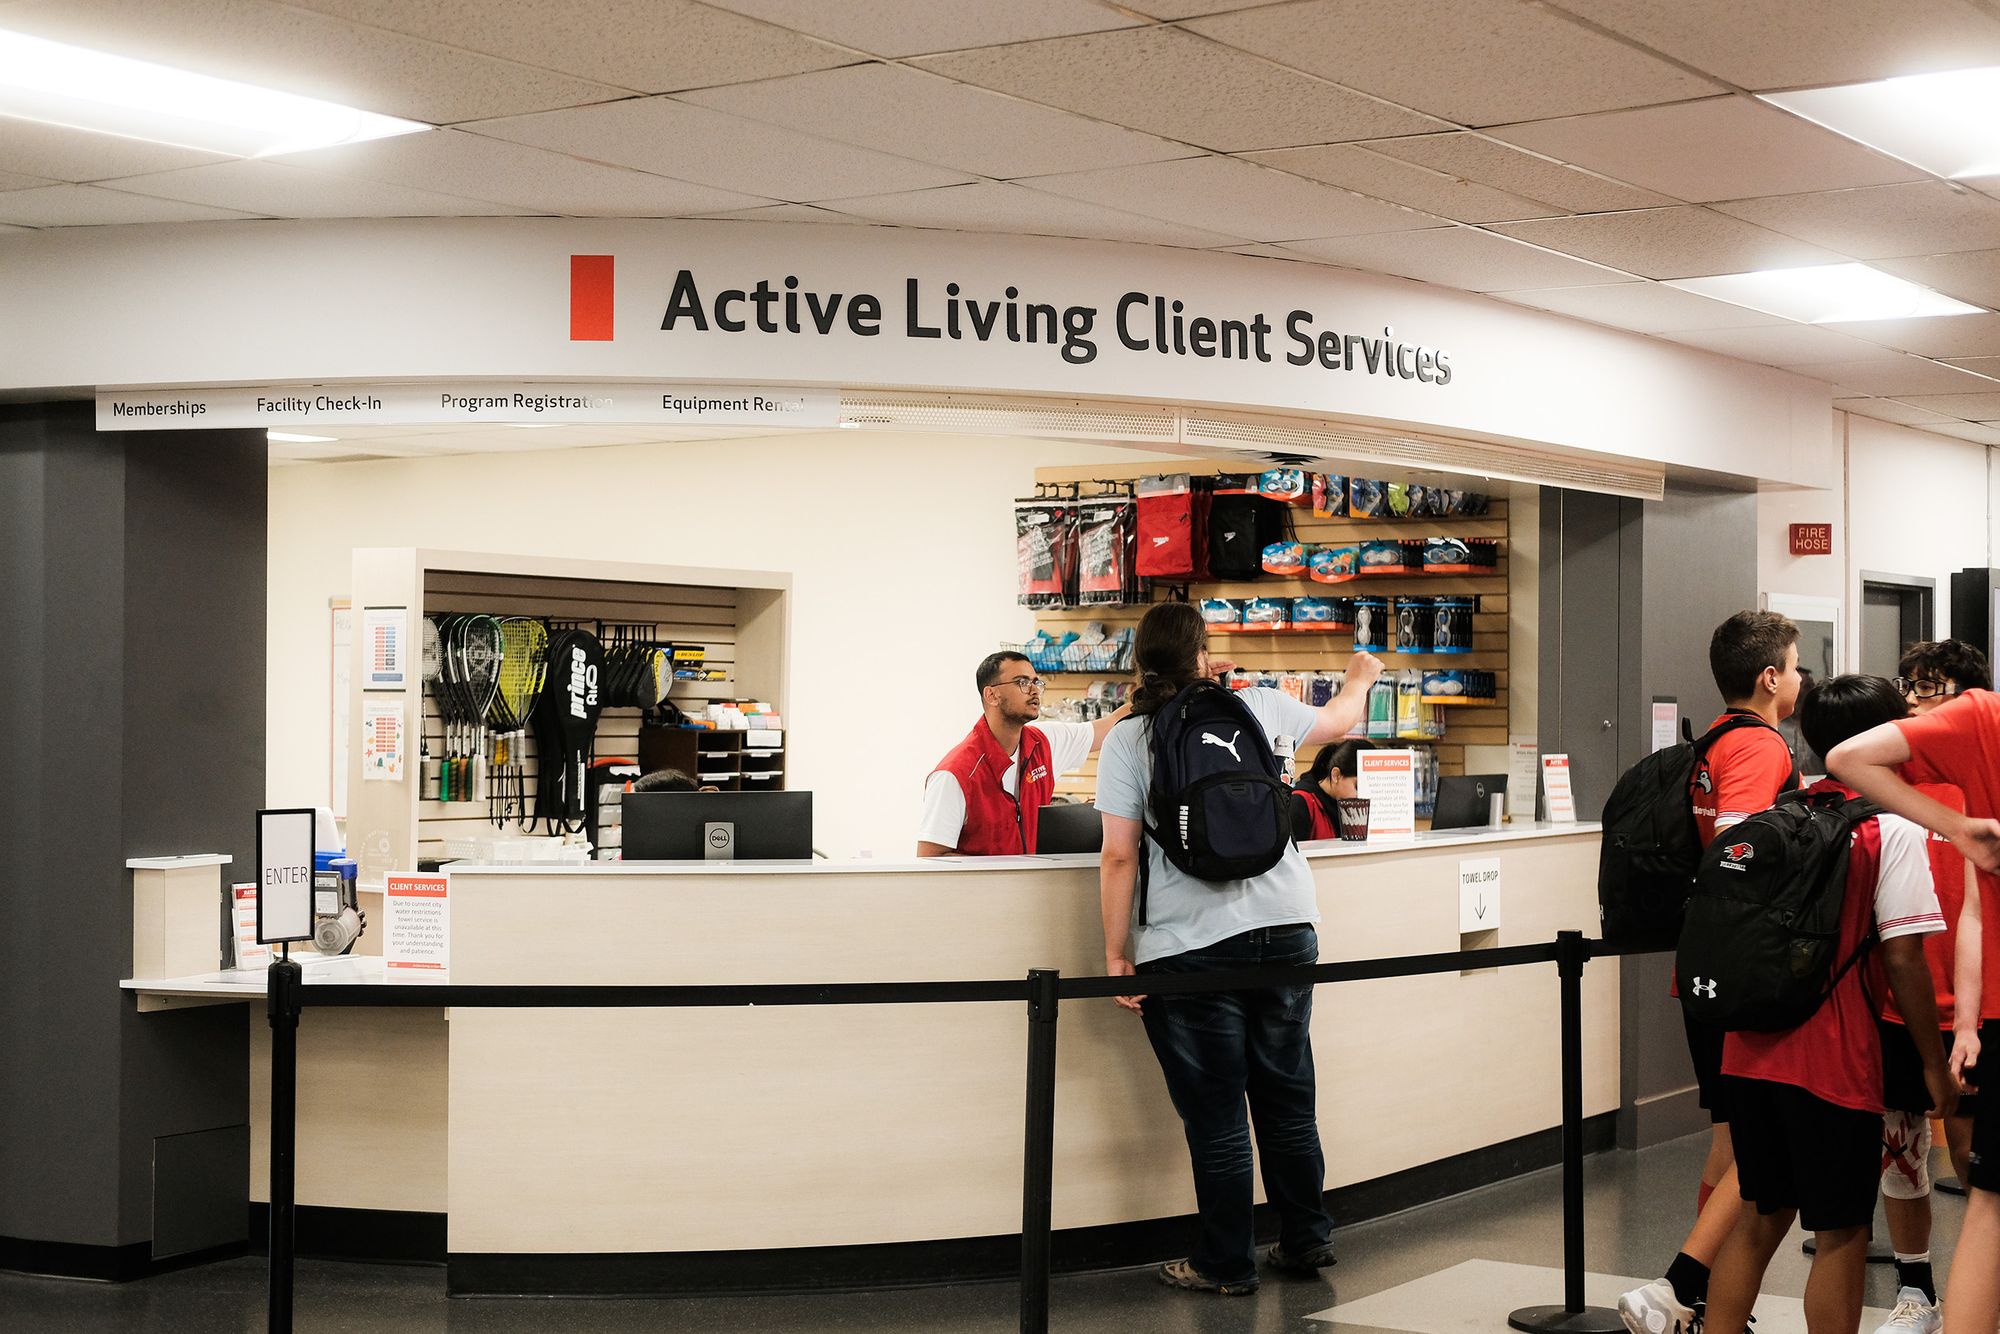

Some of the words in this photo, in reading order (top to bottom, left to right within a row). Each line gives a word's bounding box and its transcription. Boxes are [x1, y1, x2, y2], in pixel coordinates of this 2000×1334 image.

[661, 270, 881, 336] Active
[906, 278, 1098, 364] Living
[1116, 292, 1272, 362] Client
[1286, 310, 1452, 386] Services
[113, 402, 206, 417] Memberships
[257, 397, 311, 415] Facility
[315, 396, 382, 411] Check-In
[442, 394, 508, 412] Program
[663, 395, 749, 414] Equipment
[1799, 528, 1826, 538] FIRE
[1796, 539, 1829, 550] HOSE
[567, 646, 587, 719] prince
[1364, 759, 1384, 767] CLIENT
[1384, 759, 1409, 767] SERVICES
[266, 866, 309, 885] ENTER
[1463, 872, 1482, 885] TOWEL
[1483, 870, 1499, 881] DROP
[414, 884, 445, 892] SERVICES
[432, 901, 442, 909] city
[405, 940, 444, 948] understanding
